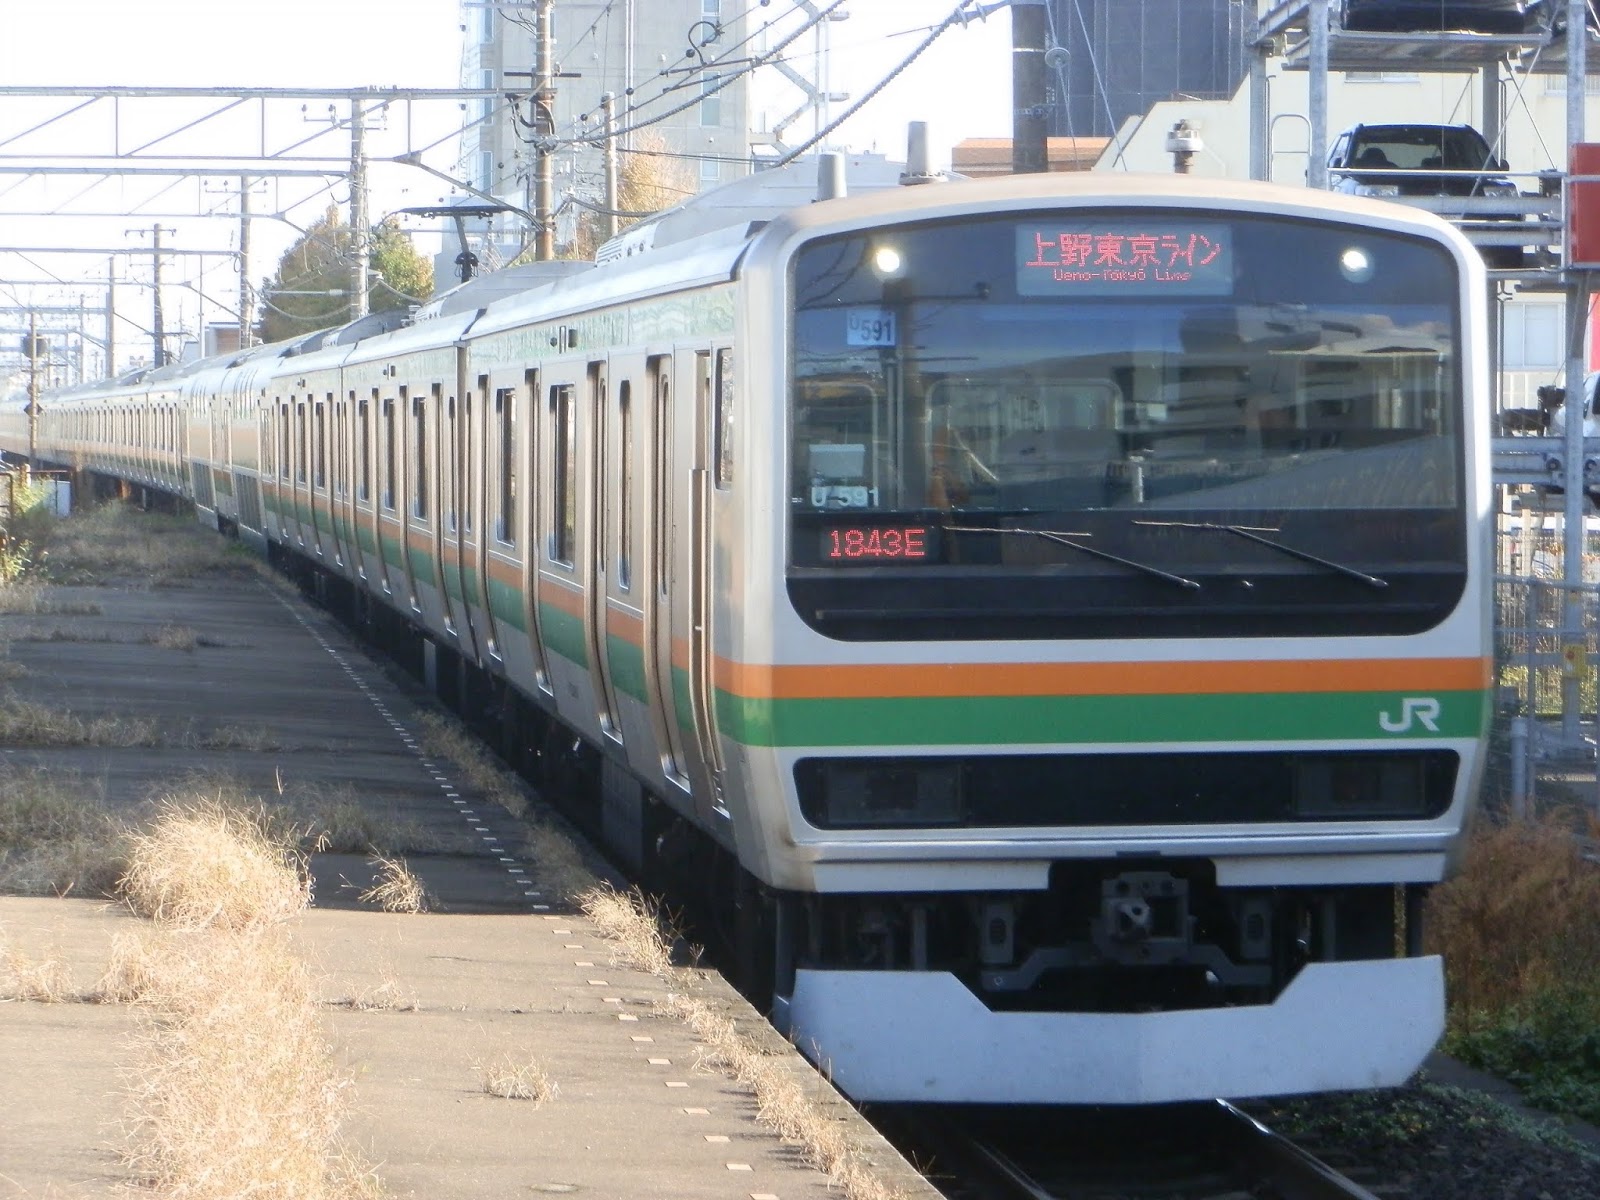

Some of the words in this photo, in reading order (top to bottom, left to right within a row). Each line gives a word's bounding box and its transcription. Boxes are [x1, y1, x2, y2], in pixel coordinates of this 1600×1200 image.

[1025, 232, 1222, 267] 上野東京ライン
[1155, 268, 1191, 281] Line
[830, 529, 925, 557] 1843E
[1379, 697, 1440, 732] JR
